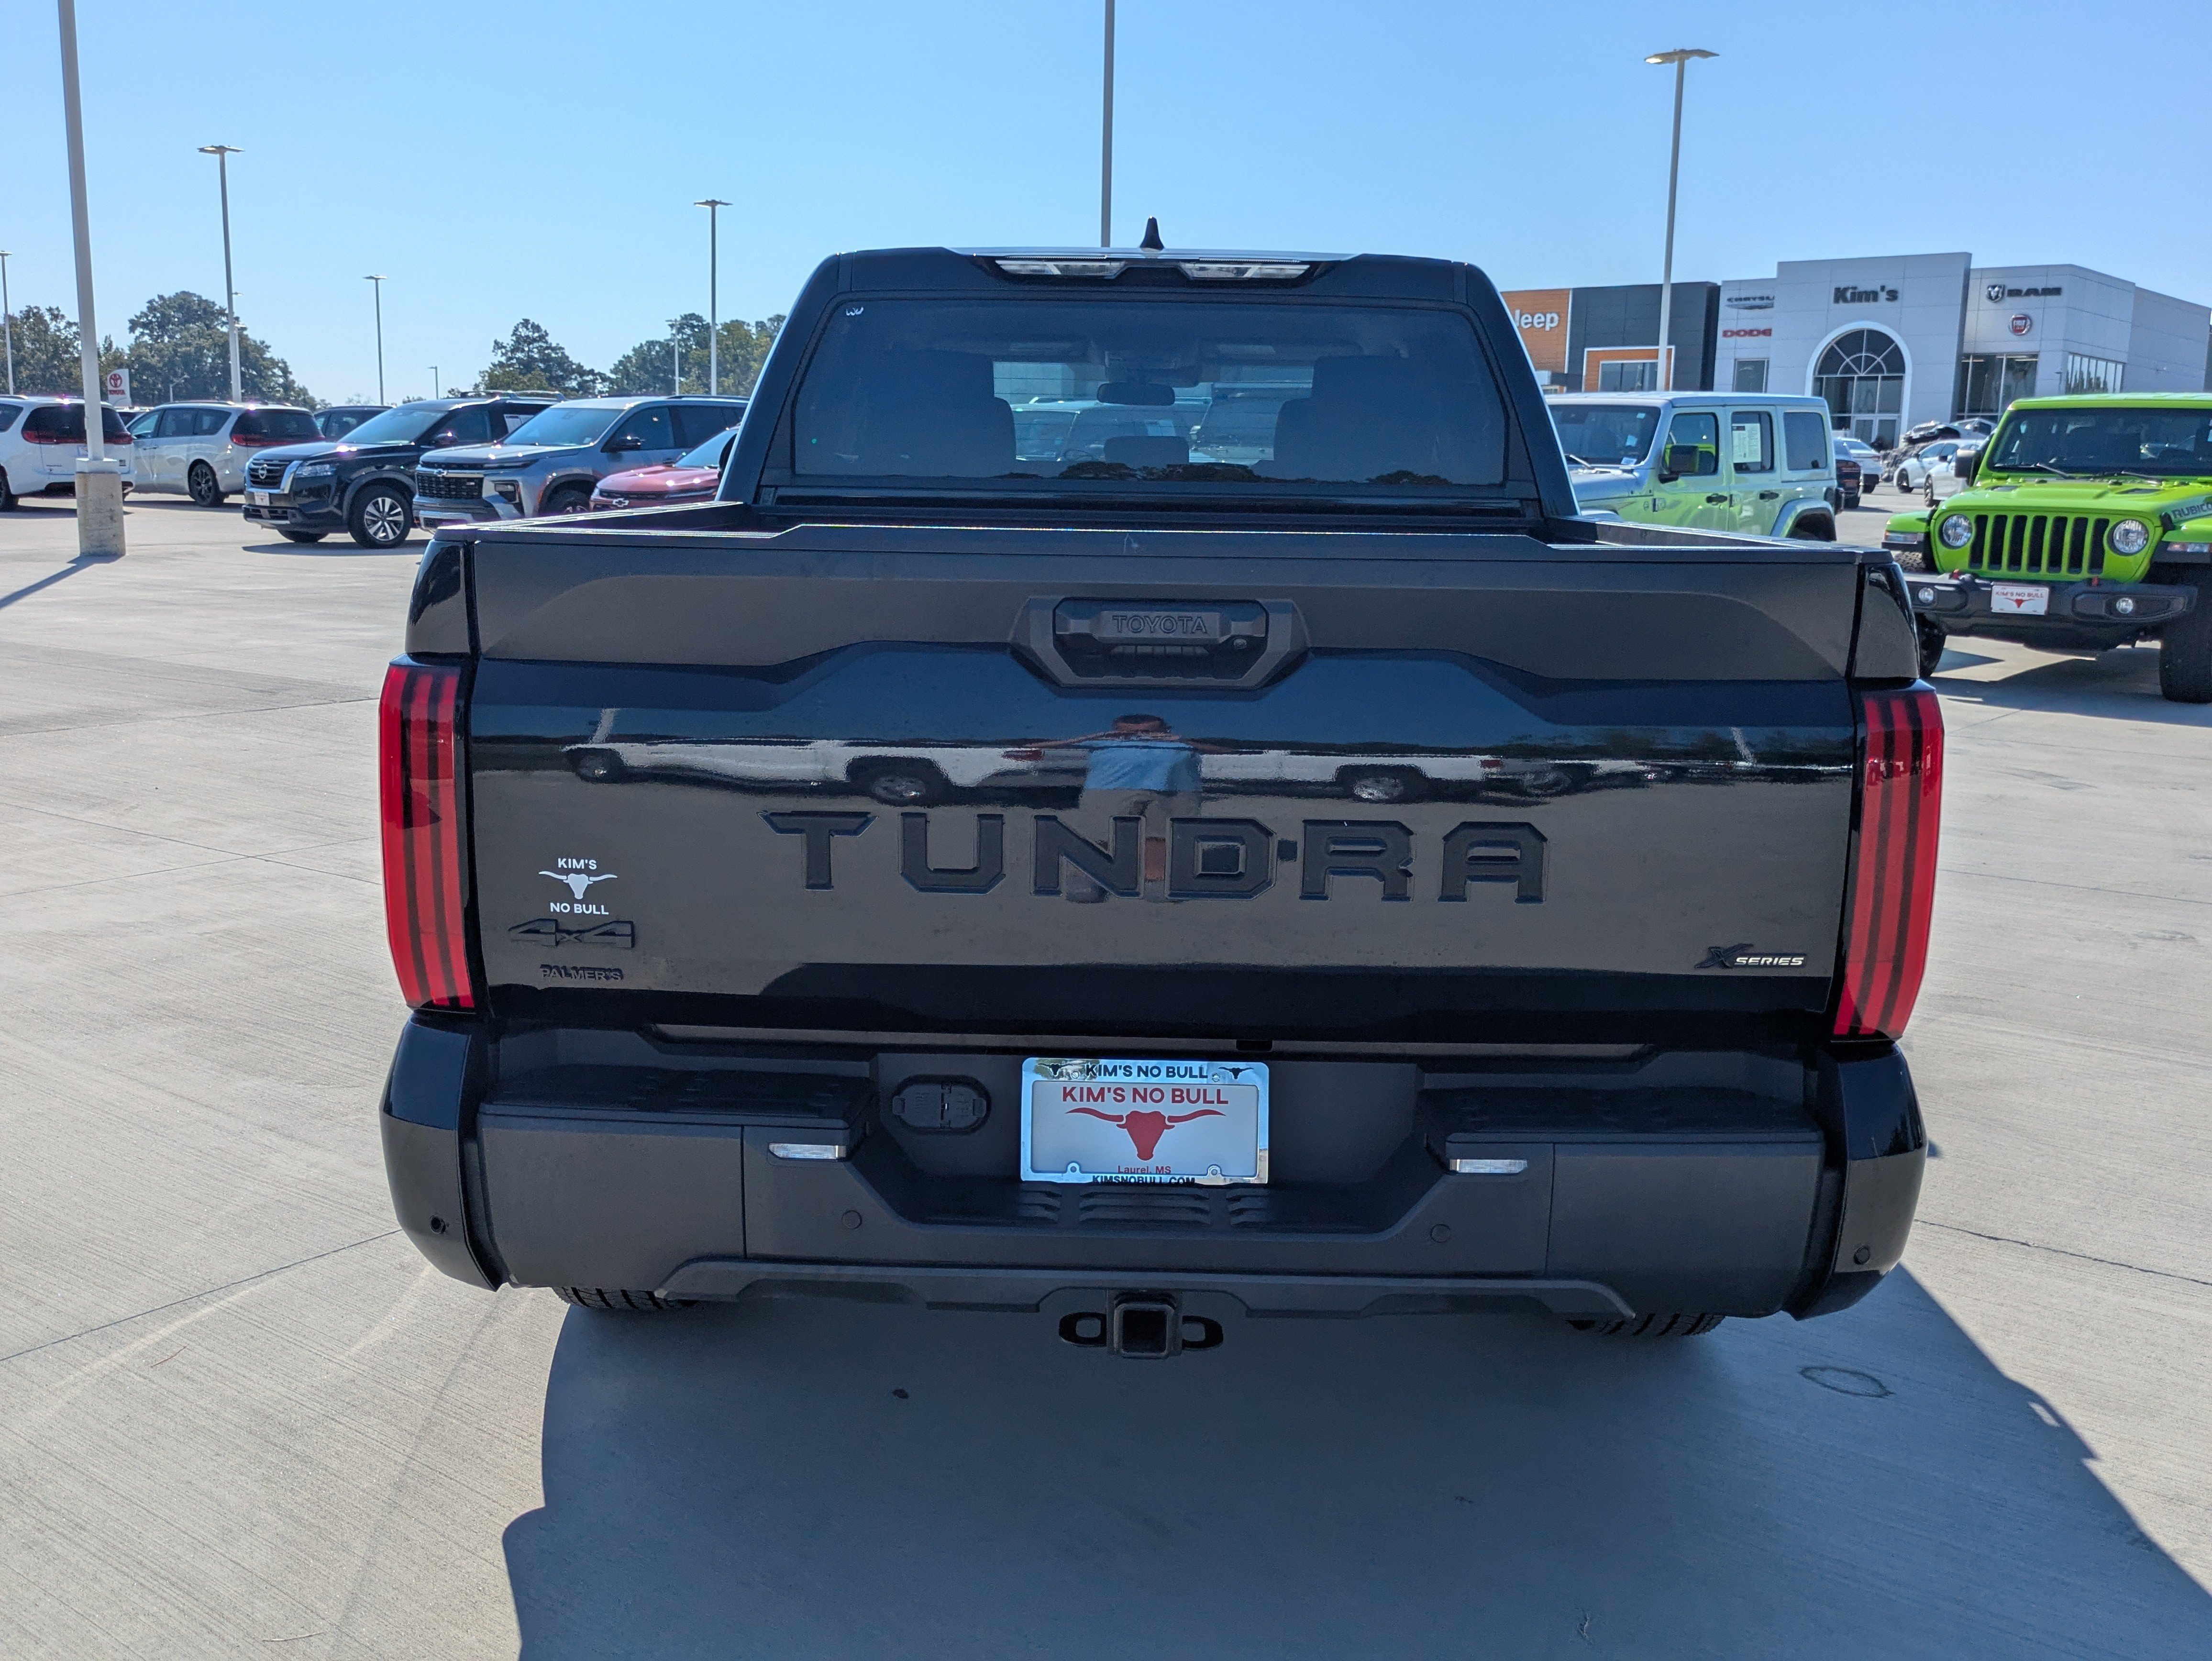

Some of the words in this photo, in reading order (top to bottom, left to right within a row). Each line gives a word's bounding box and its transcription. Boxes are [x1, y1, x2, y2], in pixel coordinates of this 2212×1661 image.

[1834, 285, 1898, 304] Kim's
[1112, 615, 1208, 634] TOYOTA
[558, 858, 597, 870] KIM'S
[757, 810, 1550, 904] TUNDRA
[550, 903, 570, 913] NO
[574, 904, 609, 915] BULL
[1734, 957, 1804, 966] SERIES
[540, 964, 624, 981] PALMER'S
[1085, 1064, 1133, 1077] KIM'S
[1137, 1065, 1162, 1078] NO
[1165, 1066, 1208, 1079] BULL
[1062, 1086, 1126, 1103] KIM'S
[1132, 1087, 1165, 1104] NO
[1171, 1088, 1229, 1105] BULL
[1155, 1166, 1172, 1174] MS
[1092, 1175, 1195, 1185] KIMSNOBULLCOM
